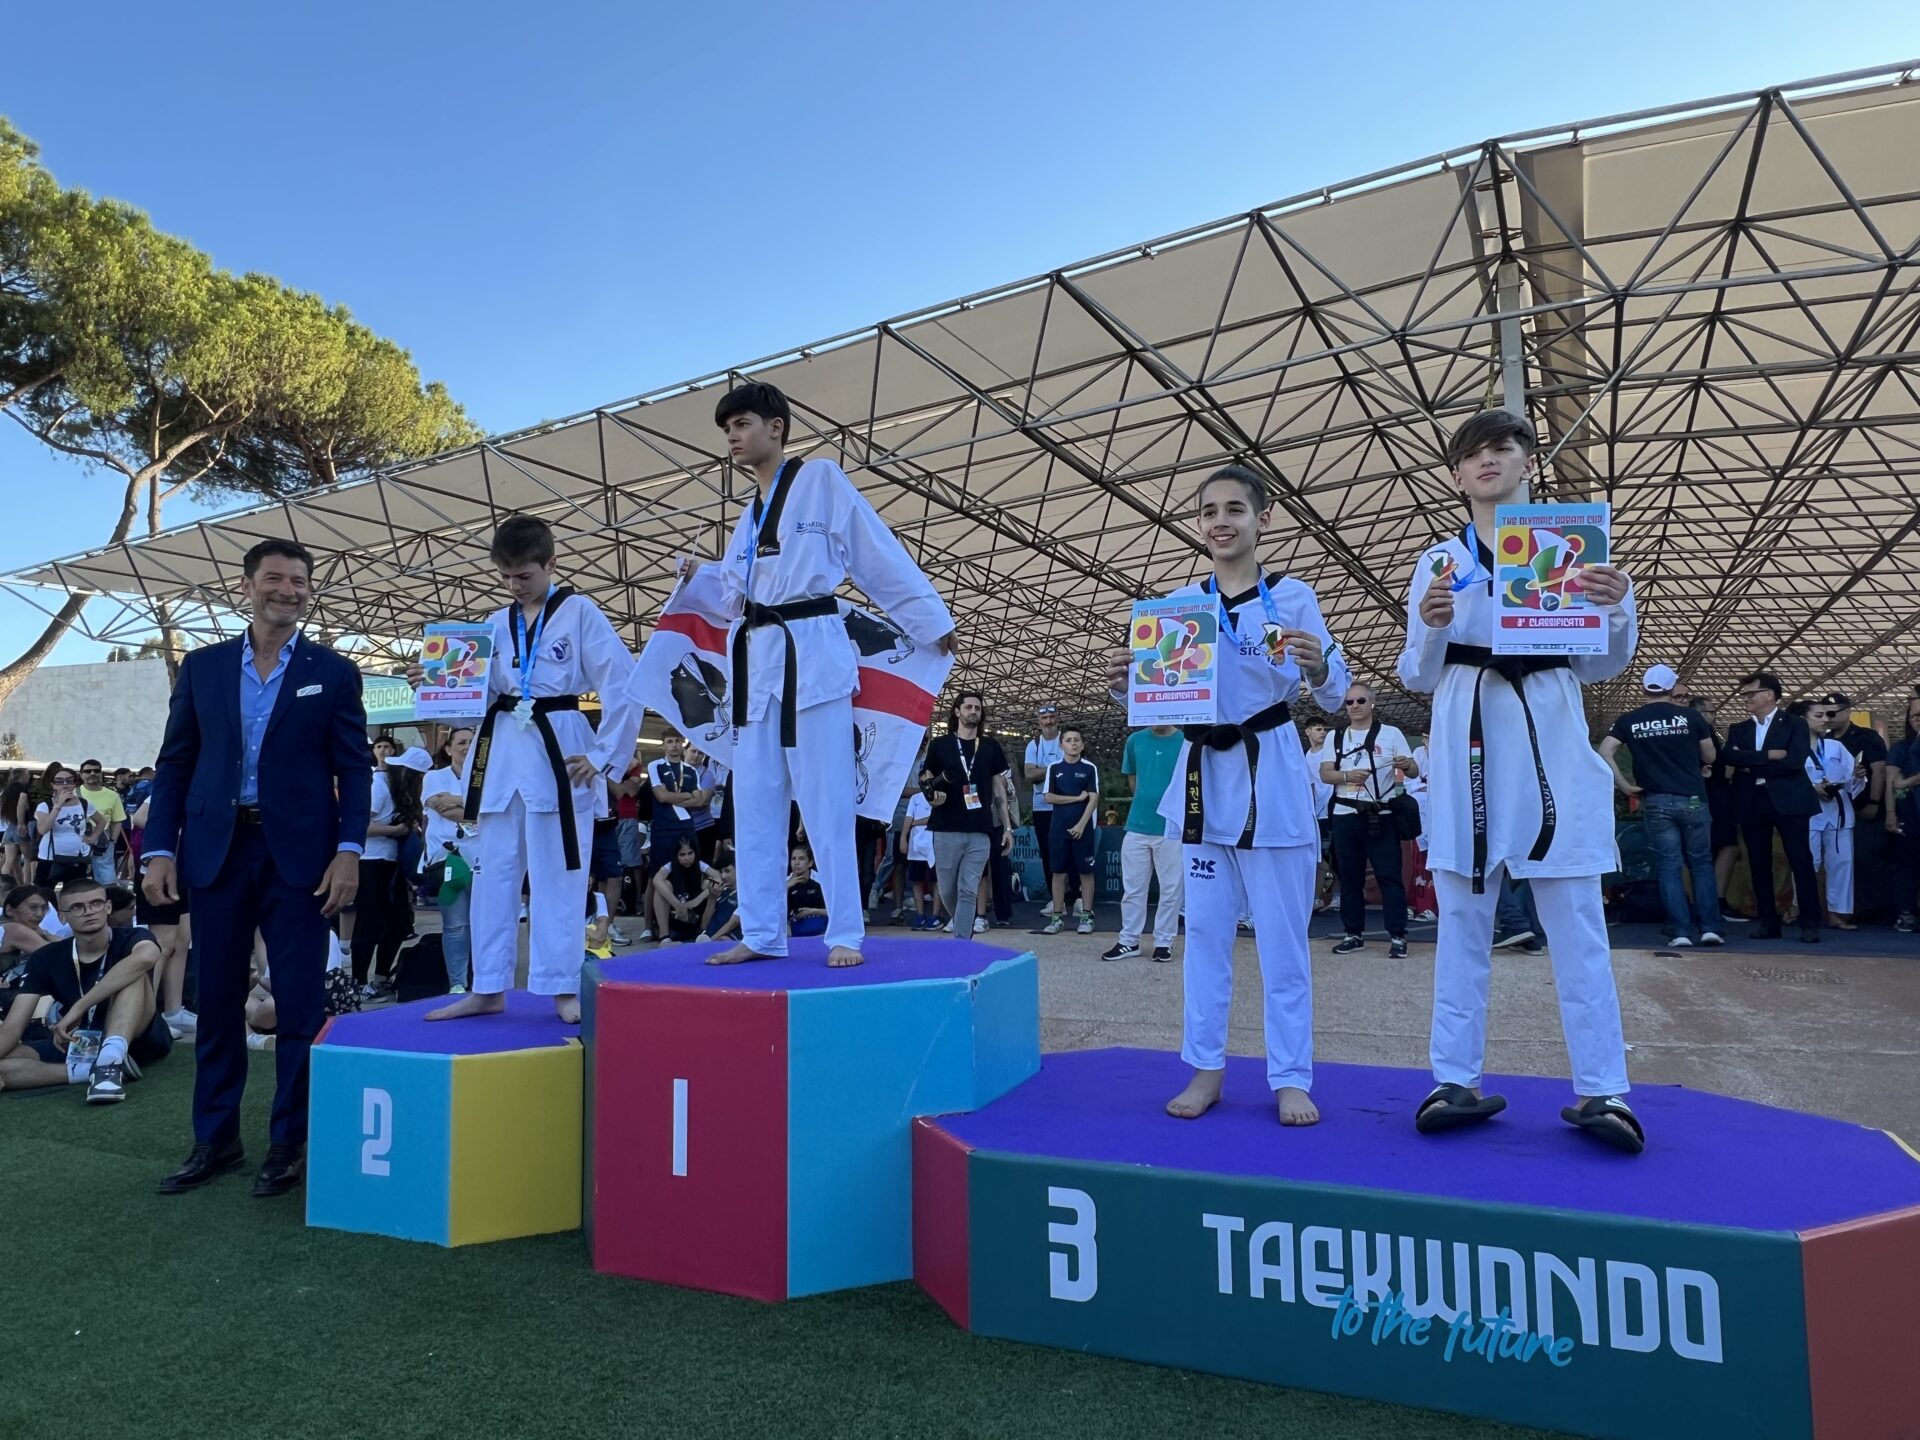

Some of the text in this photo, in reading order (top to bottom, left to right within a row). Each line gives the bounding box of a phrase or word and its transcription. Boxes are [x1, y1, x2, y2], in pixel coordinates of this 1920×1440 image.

[1502, 516, 1517, 526] THE
[1519, 515, 1553, 526] OLYMPIC
[1587, 515, 1603, 524] CUP
[1528, 617, 1585, 627] CLASSIFICATO
[1631, 715, 1688, 733] PUGLIA
[1633, 728, 1690, 739] TAEKWONDO
[1188, 770, 1201, 814] 태권도
[1471, 763, 1485, 834] TAEKWONDO
[1190, 871, 1216, 880] KPNP
[361, 1087, 392, 1177] 2
[1048, 1186, 1098, 1302] 3
[1202, 1213, 1723, 1363] TAEKWONDO
[1325, 1284, 1574, 1367] to the future
